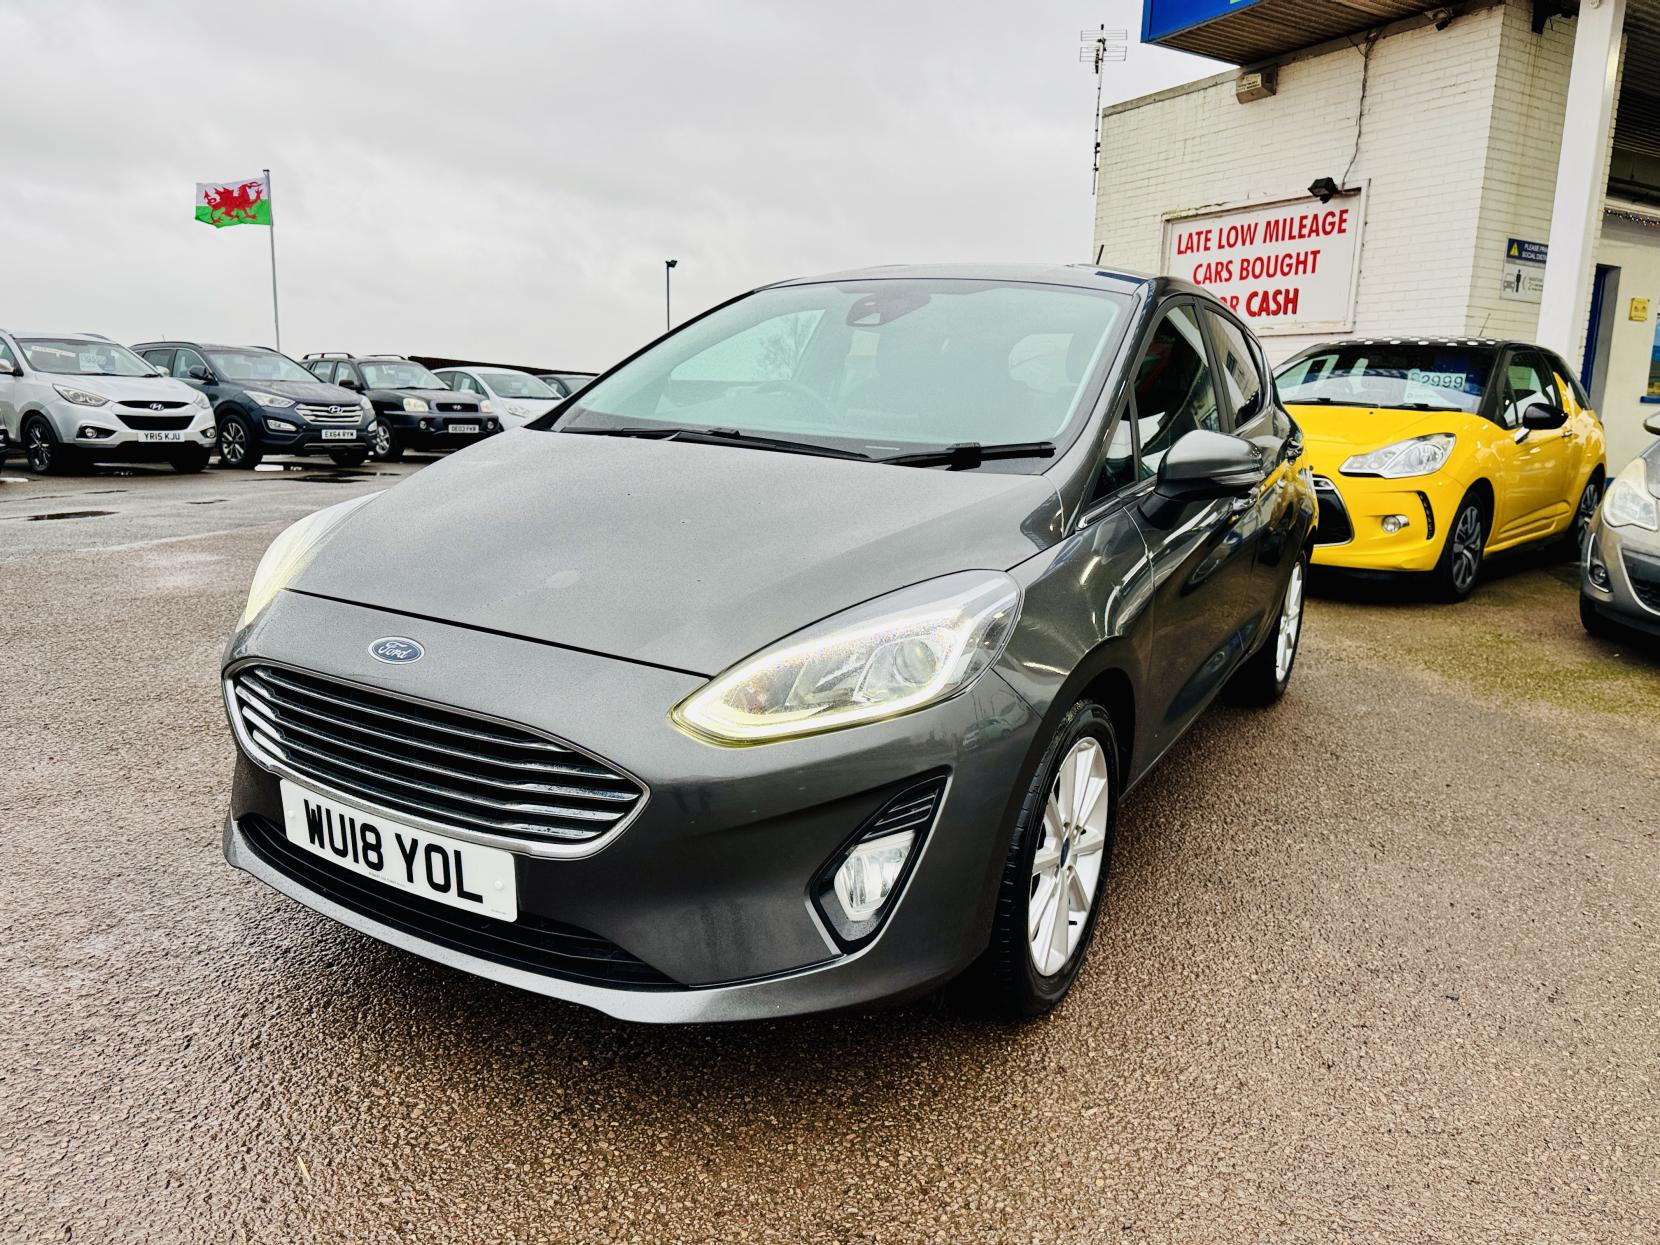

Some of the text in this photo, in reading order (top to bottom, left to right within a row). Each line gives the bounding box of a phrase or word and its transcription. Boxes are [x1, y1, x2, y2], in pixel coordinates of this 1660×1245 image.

[1177, 209, 1348, 255] LATE LOW MILEAGE
[1193, 249, 1320, 285] CARS BOUGHT
[1246, 288, 1299, 317] CASH
[144, 432, 180, 440] YR15 KJU
[378, 641, 412, 659] Ford
[303, 798, 484, 904] WU18 YOL
